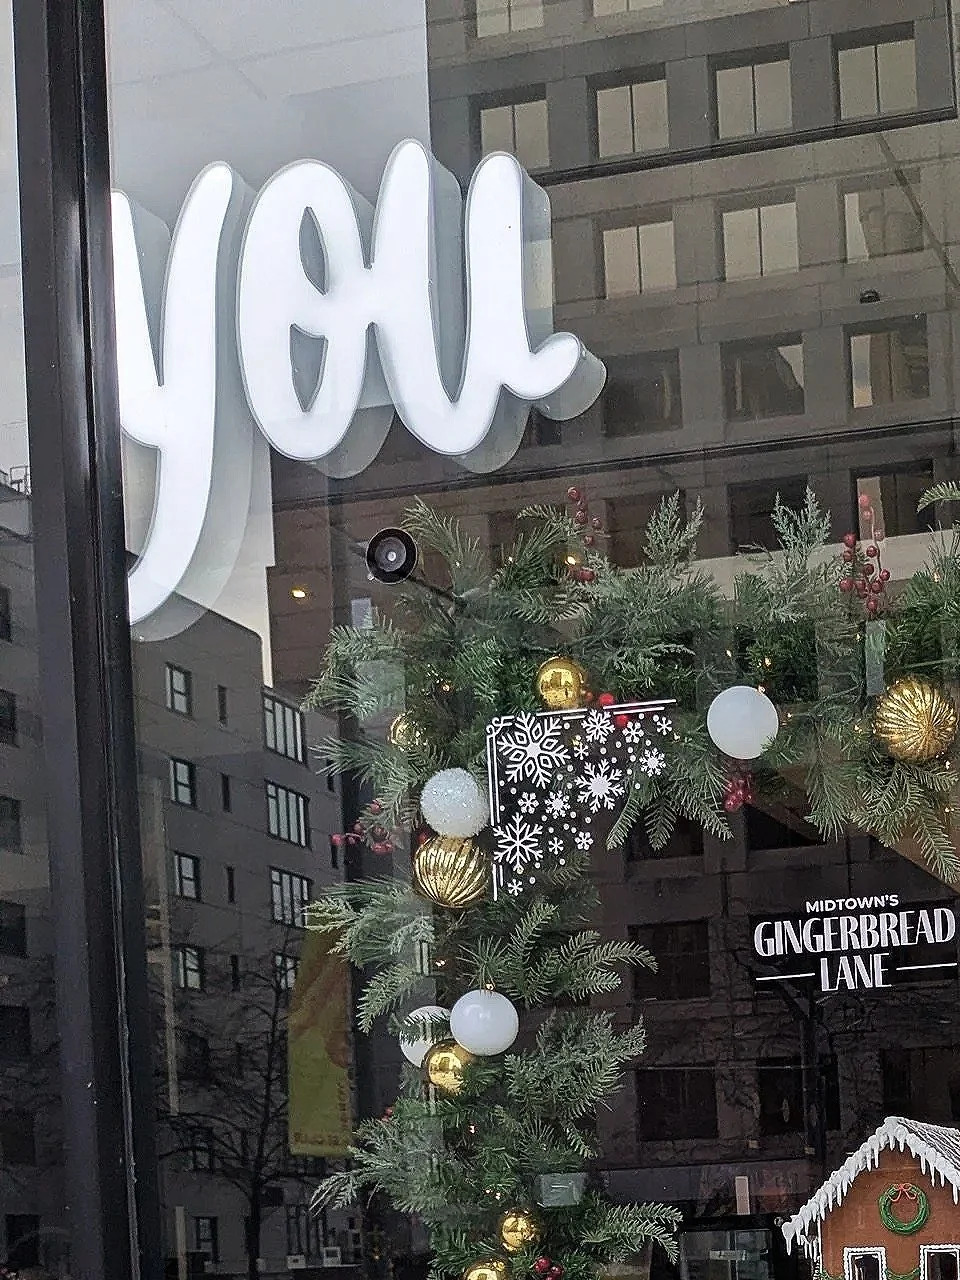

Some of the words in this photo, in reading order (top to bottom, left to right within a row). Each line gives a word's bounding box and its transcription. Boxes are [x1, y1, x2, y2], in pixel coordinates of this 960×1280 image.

[111, 138, 581, 626] you
[806, 894, 899, 913] MIDTOWN'S
[754, 908, 956, 957] GINGERBREAD
[820, 952, 893, 992] LANE
